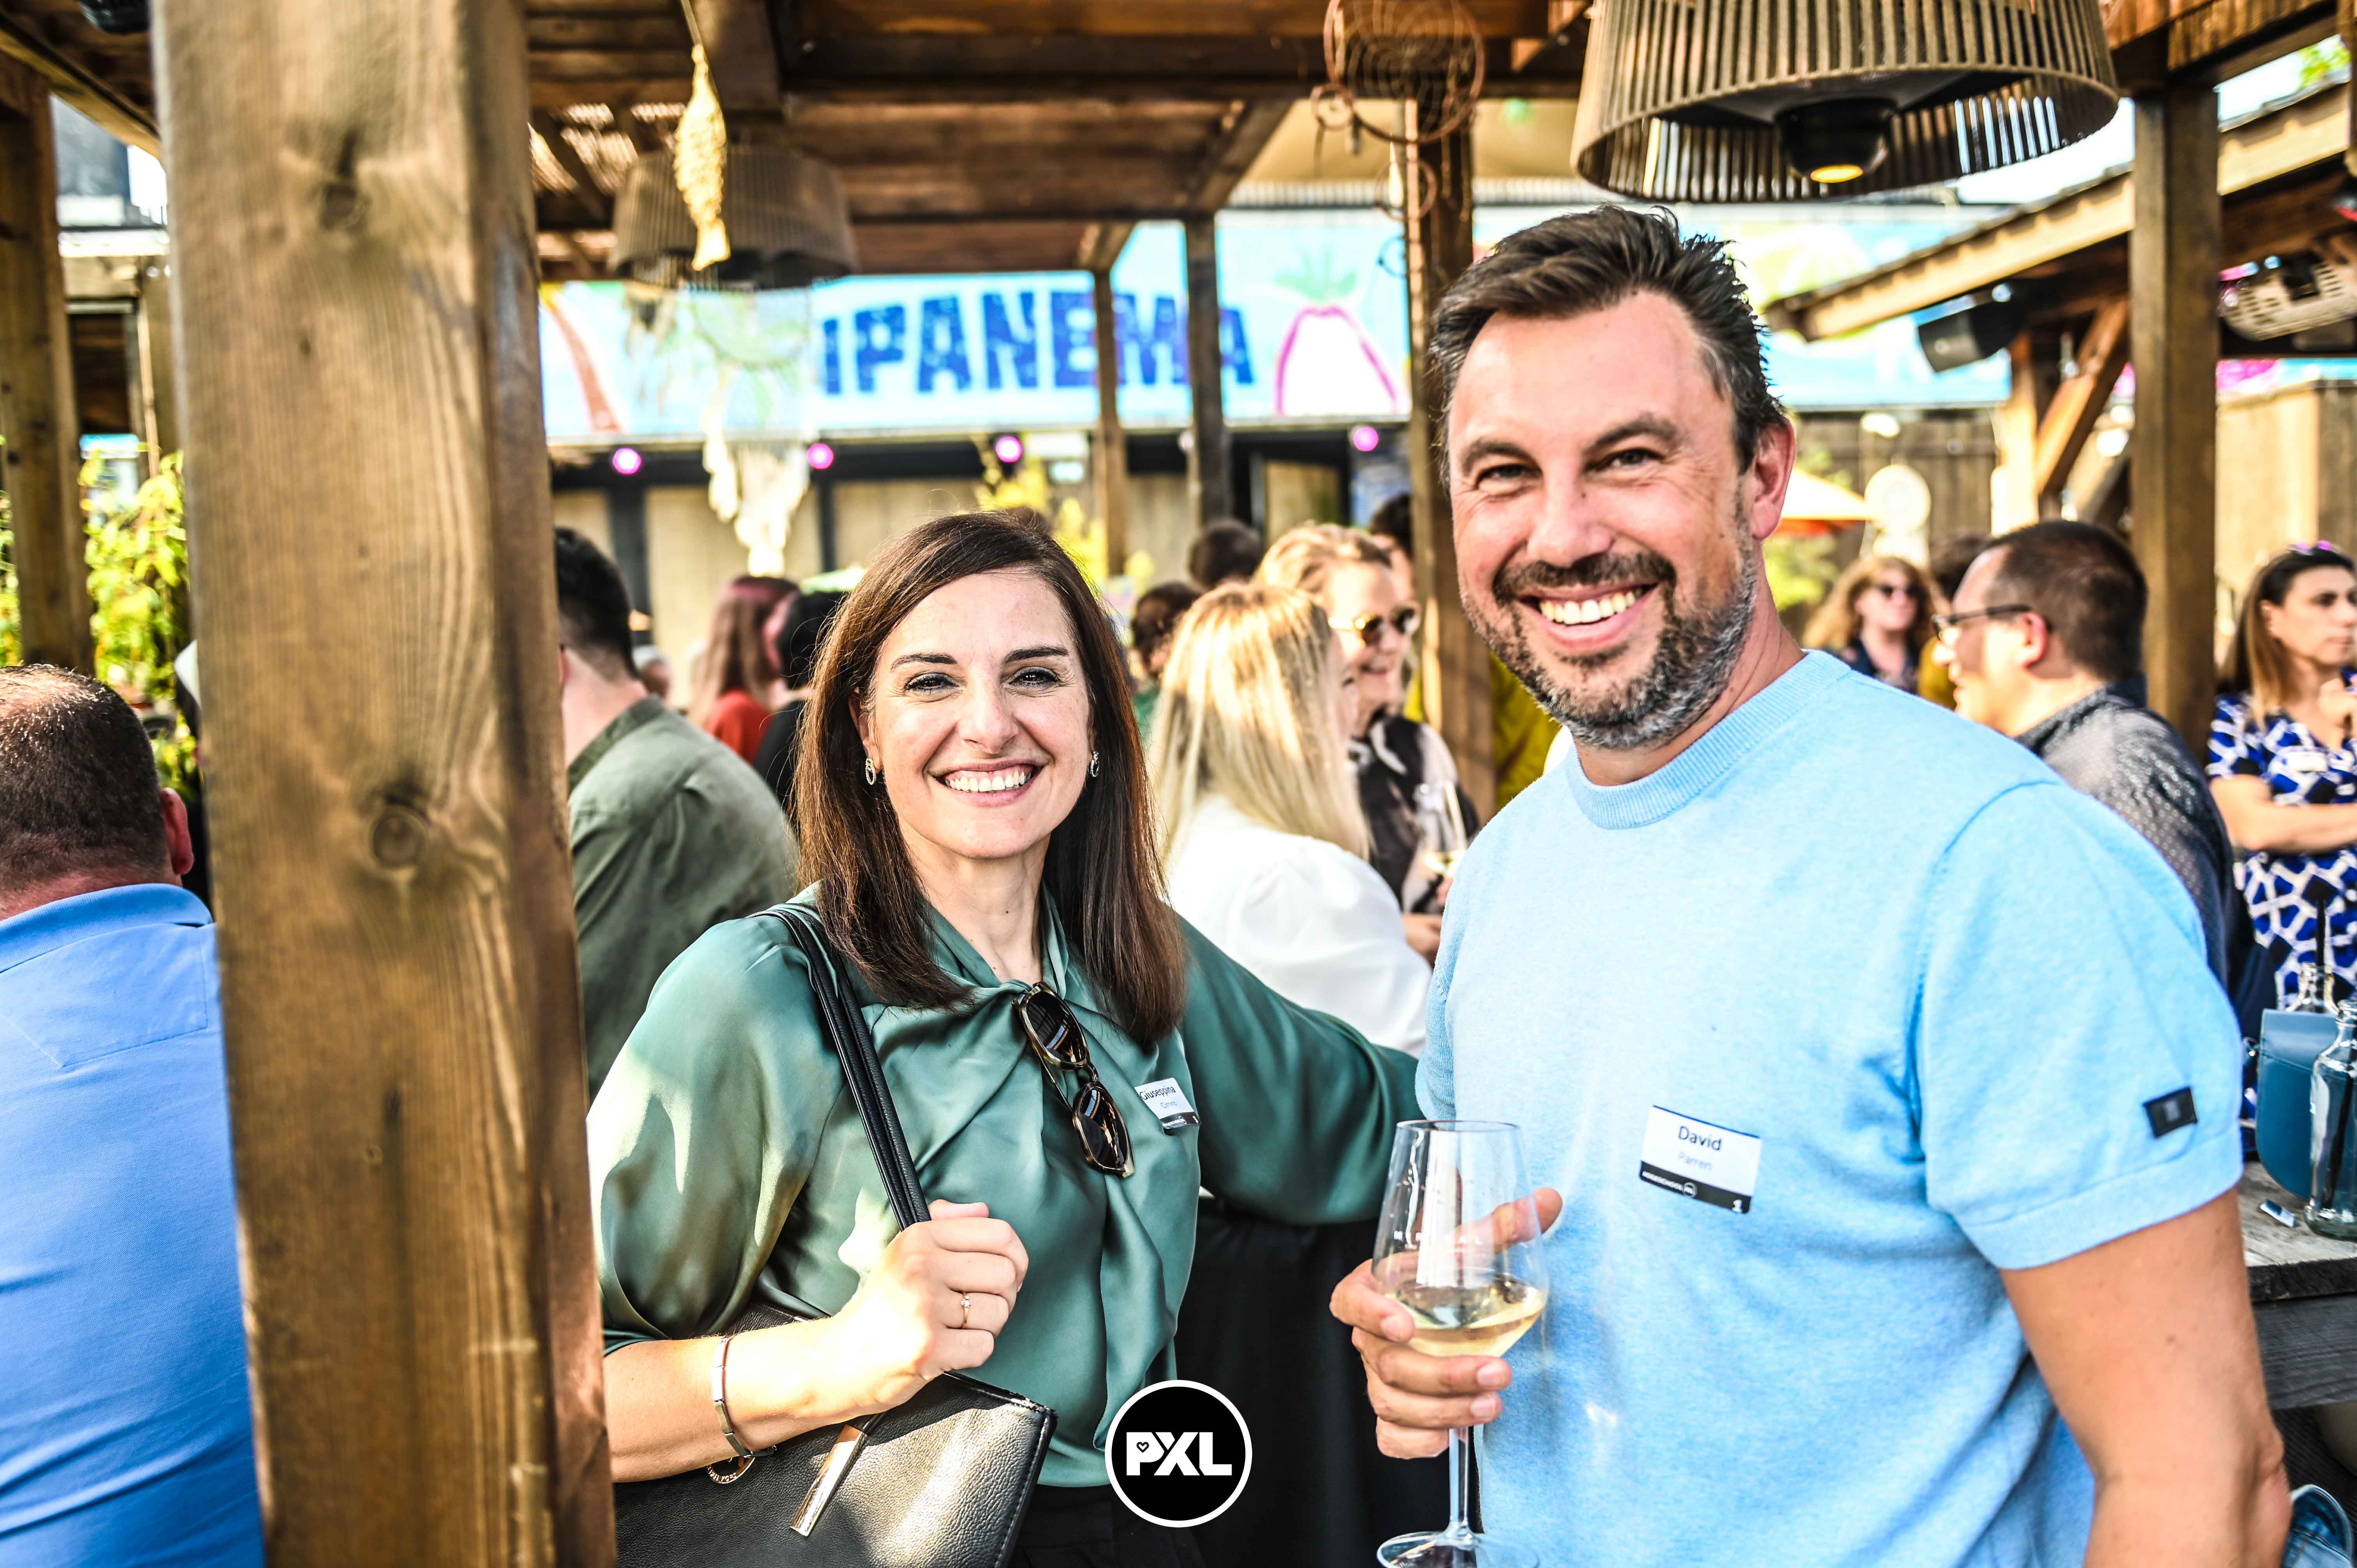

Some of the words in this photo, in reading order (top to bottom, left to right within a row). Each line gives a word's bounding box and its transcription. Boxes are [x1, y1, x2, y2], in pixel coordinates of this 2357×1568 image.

[822, 290, 1254, 394] IPANEMA
[1140, 1085, 1176, 1100] Giuseppina
[1679, 1126, 1721, 1151] David
